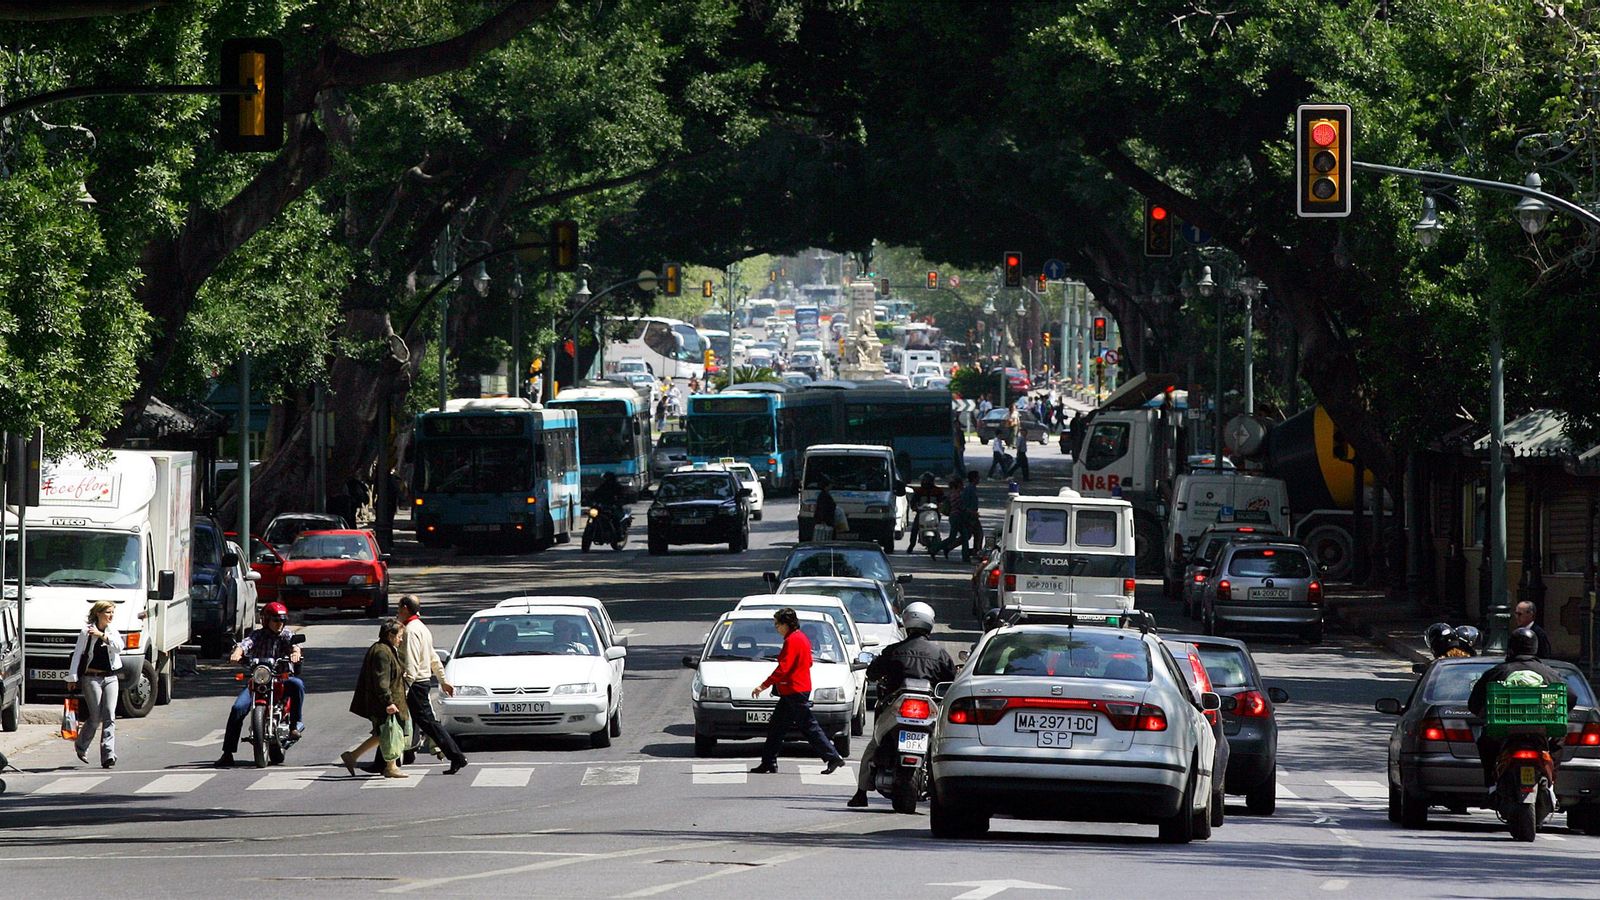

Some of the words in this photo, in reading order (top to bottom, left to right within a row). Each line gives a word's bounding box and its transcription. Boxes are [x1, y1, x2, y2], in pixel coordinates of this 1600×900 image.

[53, 518, 86, 526] IVECO
[1040, 557, 1069, 566] POLICIA
[37, 671, 57, 679] 1858
[512, 703, 532, 712] 3871
[533, 703, 545, 712] CY
